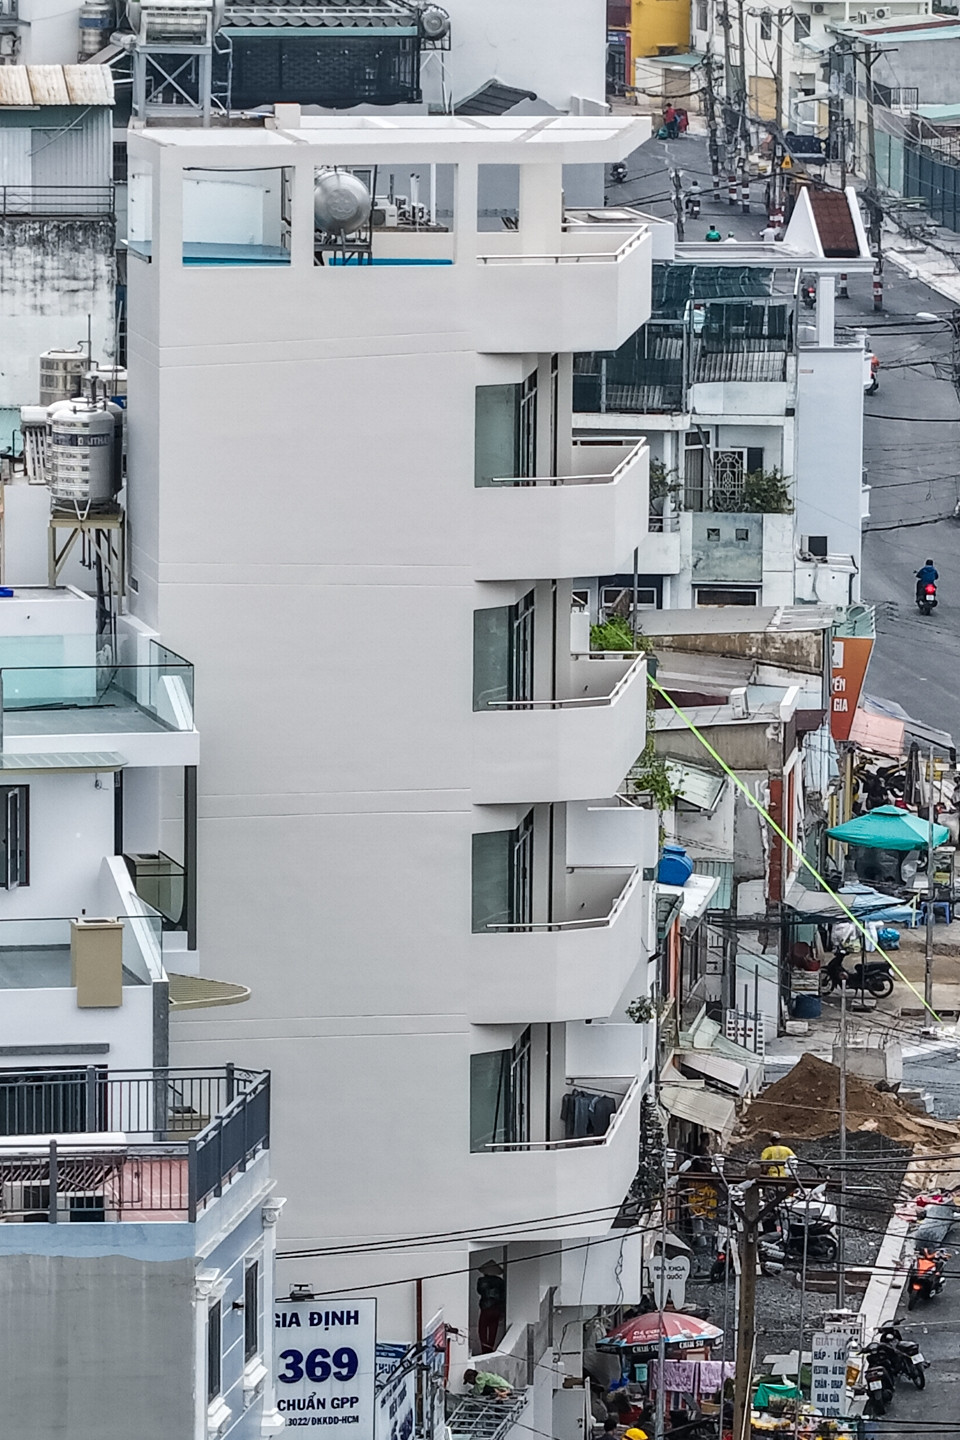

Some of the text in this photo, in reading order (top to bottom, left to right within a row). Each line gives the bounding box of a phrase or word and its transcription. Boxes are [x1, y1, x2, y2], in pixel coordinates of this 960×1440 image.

[309, 1310, 359, 1331] ĐỊNH
[278, 1347, 359, 1384] 369
[277, 1392, 359, 1412] CHUẨN GPP
